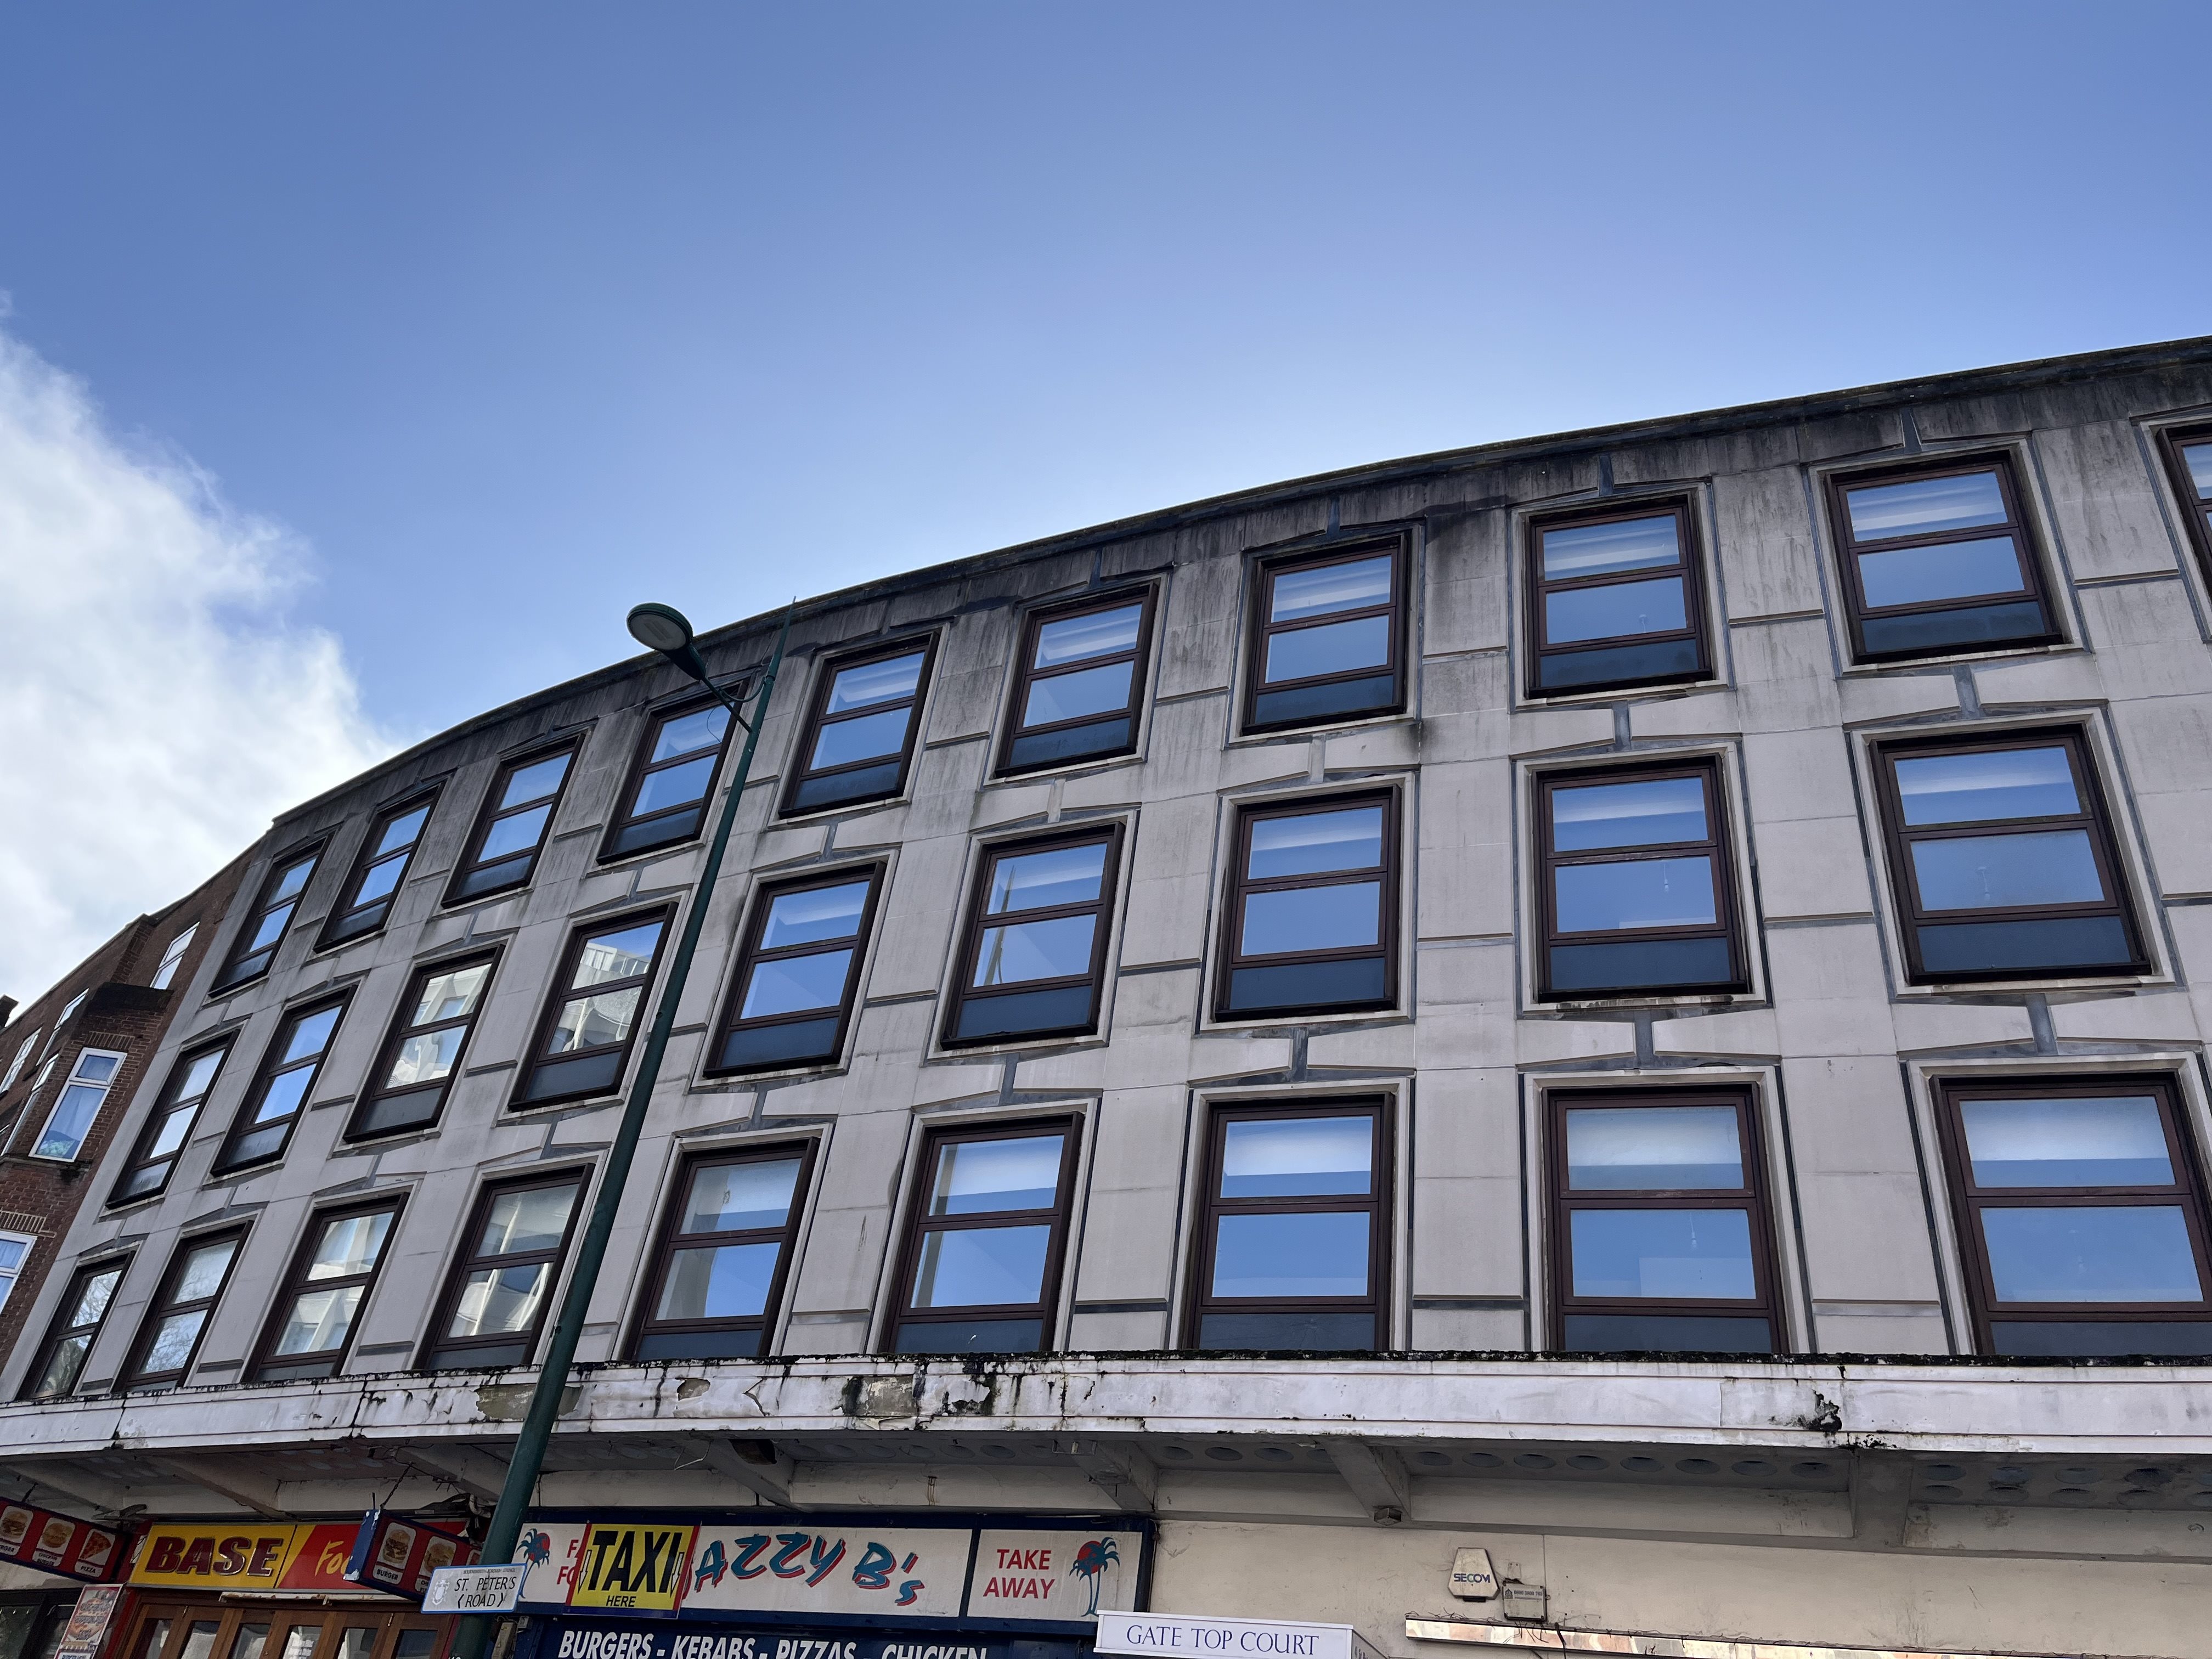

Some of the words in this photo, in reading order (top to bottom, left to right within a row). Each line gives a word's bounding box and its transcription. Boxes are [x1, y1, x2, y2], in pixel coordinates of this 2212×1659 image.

[144, 1536, 284, 1577] BASE
[588, 1531, 683, 1593] TAXI
[682, 1532, 846, 1600] AZZY
[996, 1549, 1052, 1570] TAKE
[80, 1565, 97, 1574] PIZZA
[376, 1568, 398, 1581] BURGER
[1453, 1573, 1491, 1583] SECOM
[454, 1578, 470, 1592] ST.
[476, 1576, 517, 1591] PETER'S
[983, 1577, 1056, 1599] AWAY
[465, 1593, 496, 1608] ROAD
[606, 1595, 636, 1607] HERE
[558, 1630, 654, 1659] BURGERS
[671, 1635, 756, 1659] KEBABS
[775, 1639, 857, 1659] PIZZAS
[1126, 1624, 1182, 1647] GATE
[1190, 1628, 1233, 1649] TOP
[1240, 1631, 1319, 1656] COURT
